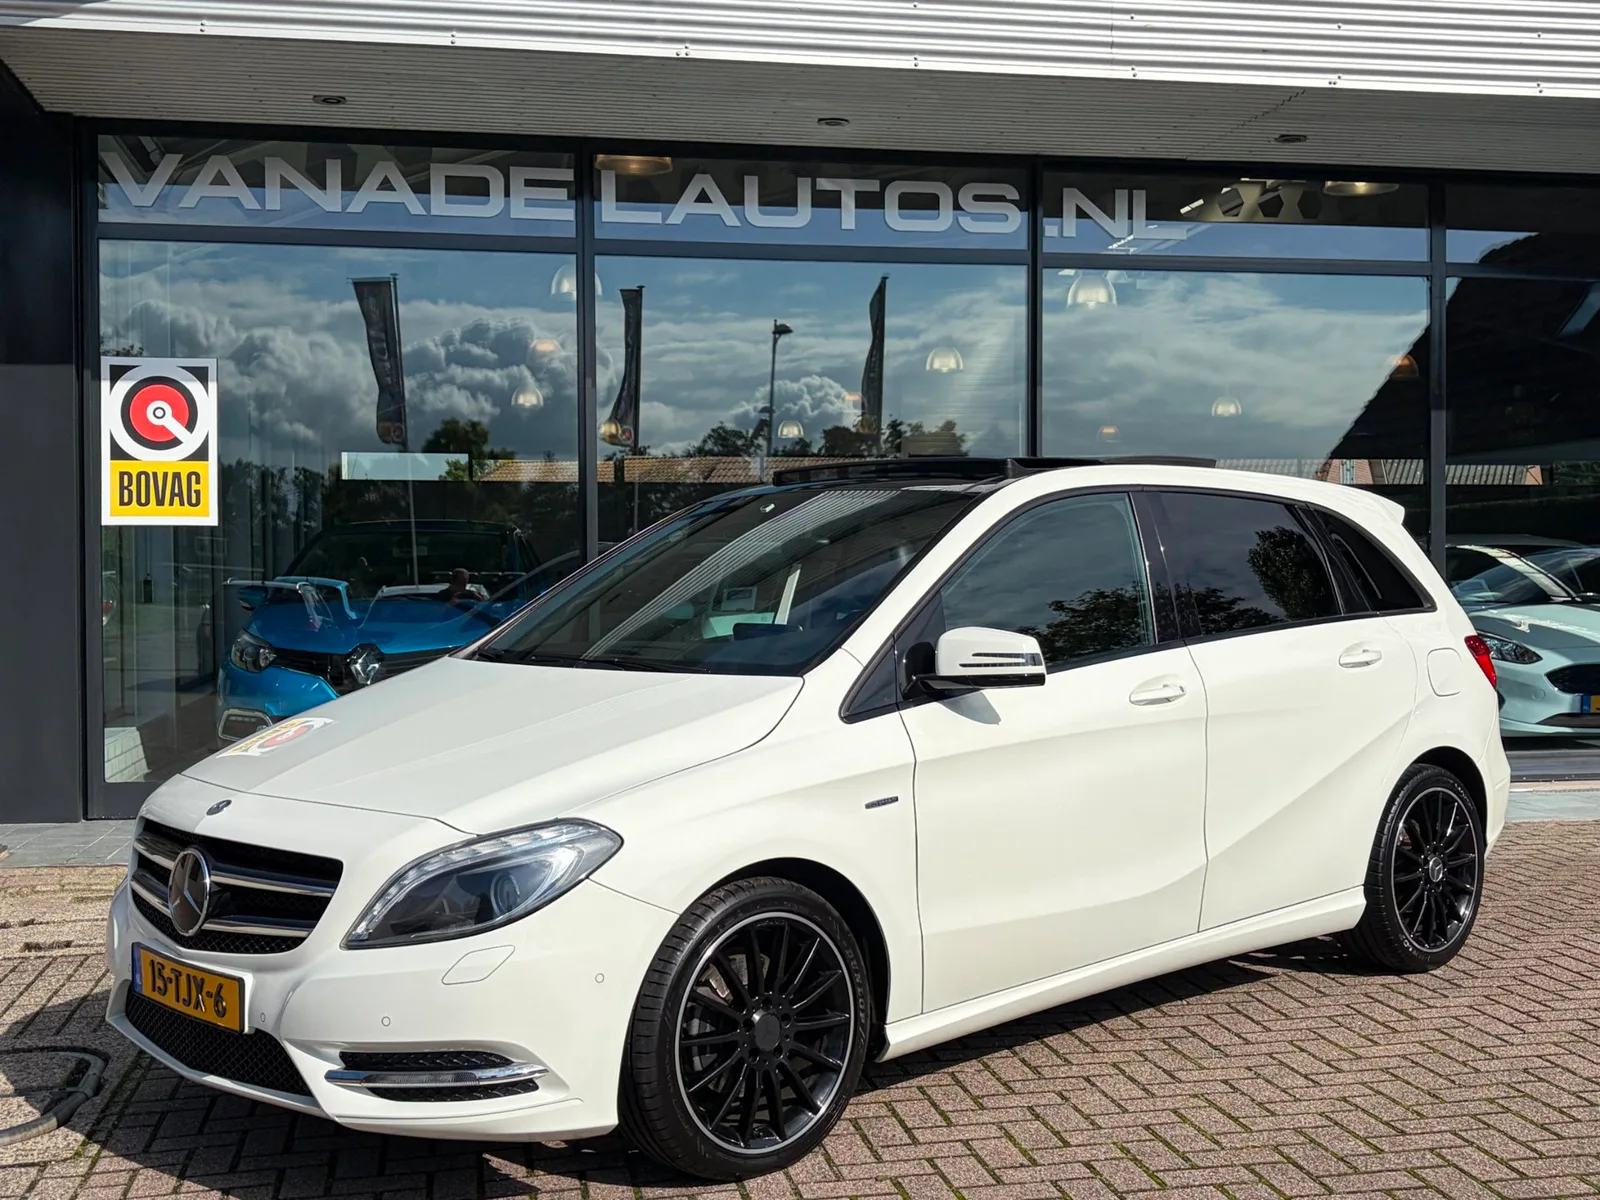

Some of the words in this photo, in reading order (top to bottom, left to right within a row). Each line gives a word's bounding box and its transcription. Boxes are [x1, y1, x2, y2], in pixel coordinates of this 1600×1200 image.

[118, 471, 201, 507] BOVAG
[149, 959, 227, 1018] 15-TJX-6
[845, 948, 866, 1024] DUNLOP
